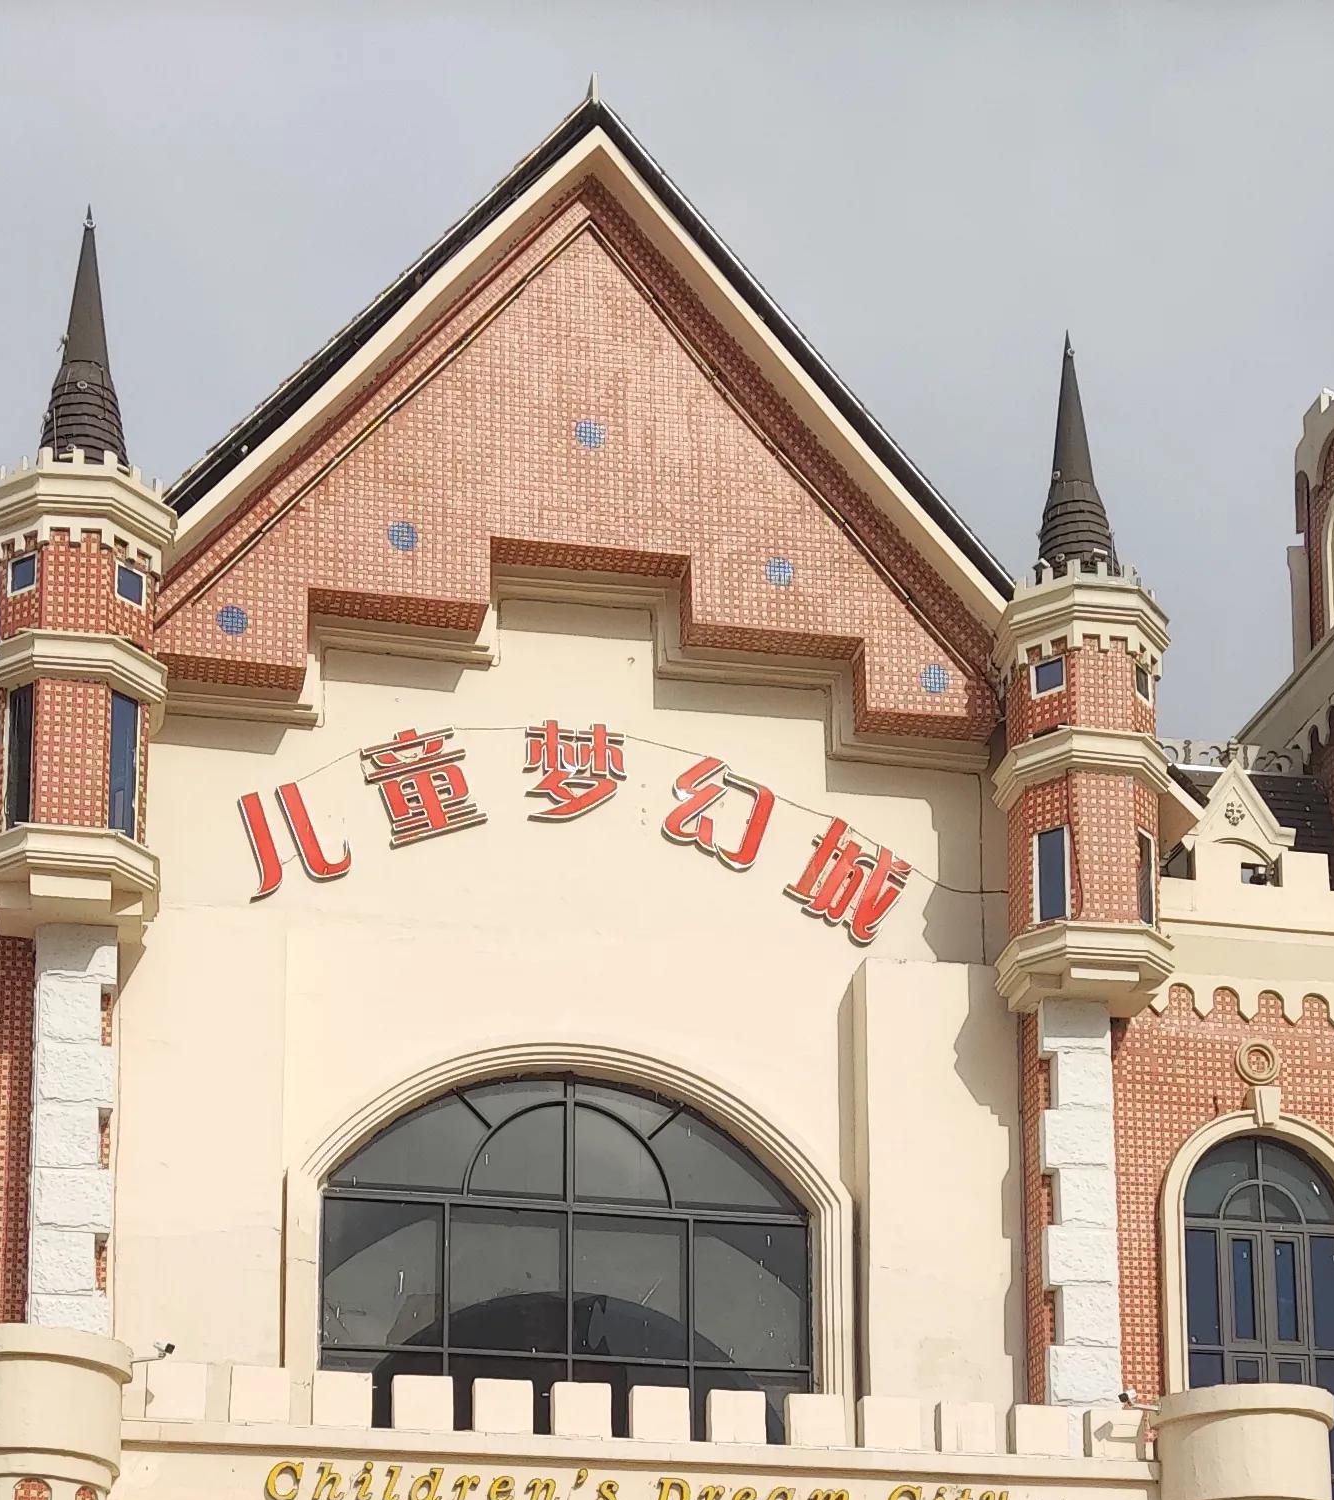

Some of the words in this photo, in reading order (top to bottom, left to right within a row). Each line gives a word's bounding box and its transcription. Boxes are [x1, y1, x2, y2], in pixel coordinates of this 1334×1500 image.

[238, 720, 912, 946] 儿童梦幻城
